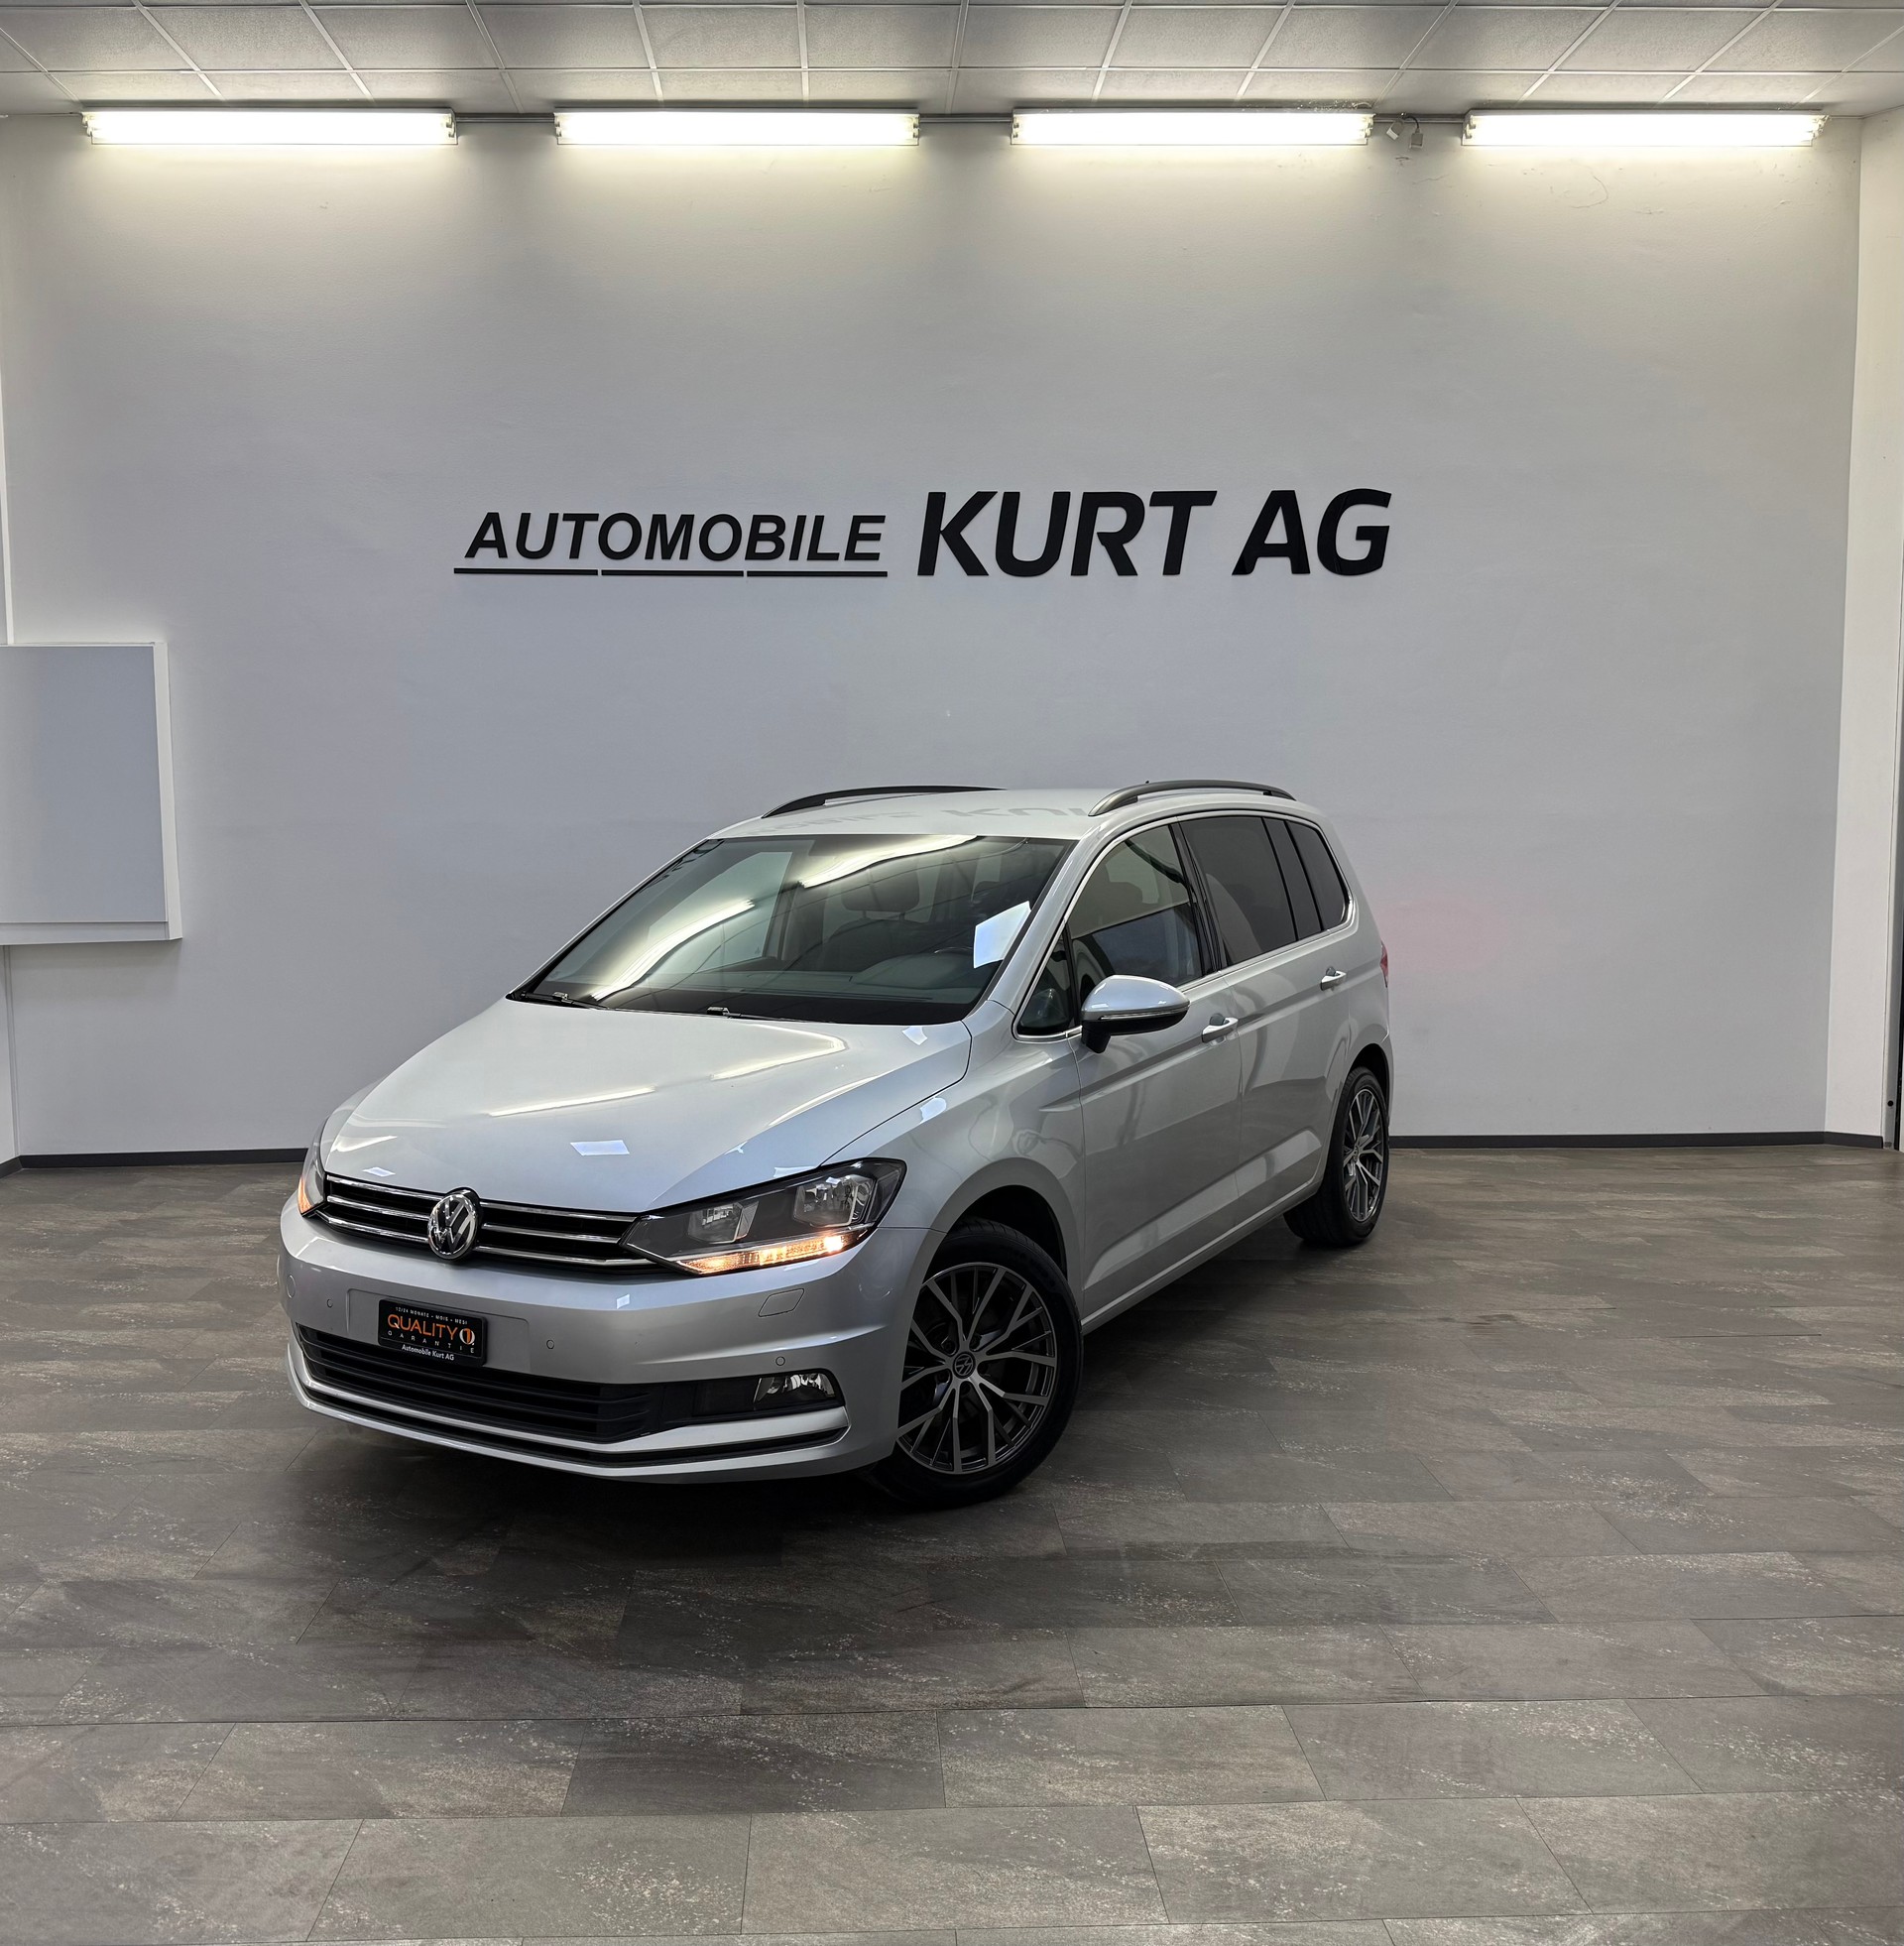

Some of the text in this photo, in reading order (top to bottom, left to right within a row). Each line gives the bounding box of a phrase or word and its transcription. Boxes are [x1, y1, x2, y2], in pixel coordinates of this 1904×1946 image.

[465, 488, 1392, 576] AUTOMOBILE KURT AG
[387, 1314, 458, 1341] QUALITY
[402, 1344, 431, 1356] Automobile
[432, 1350, 444, 1359] Kurt
